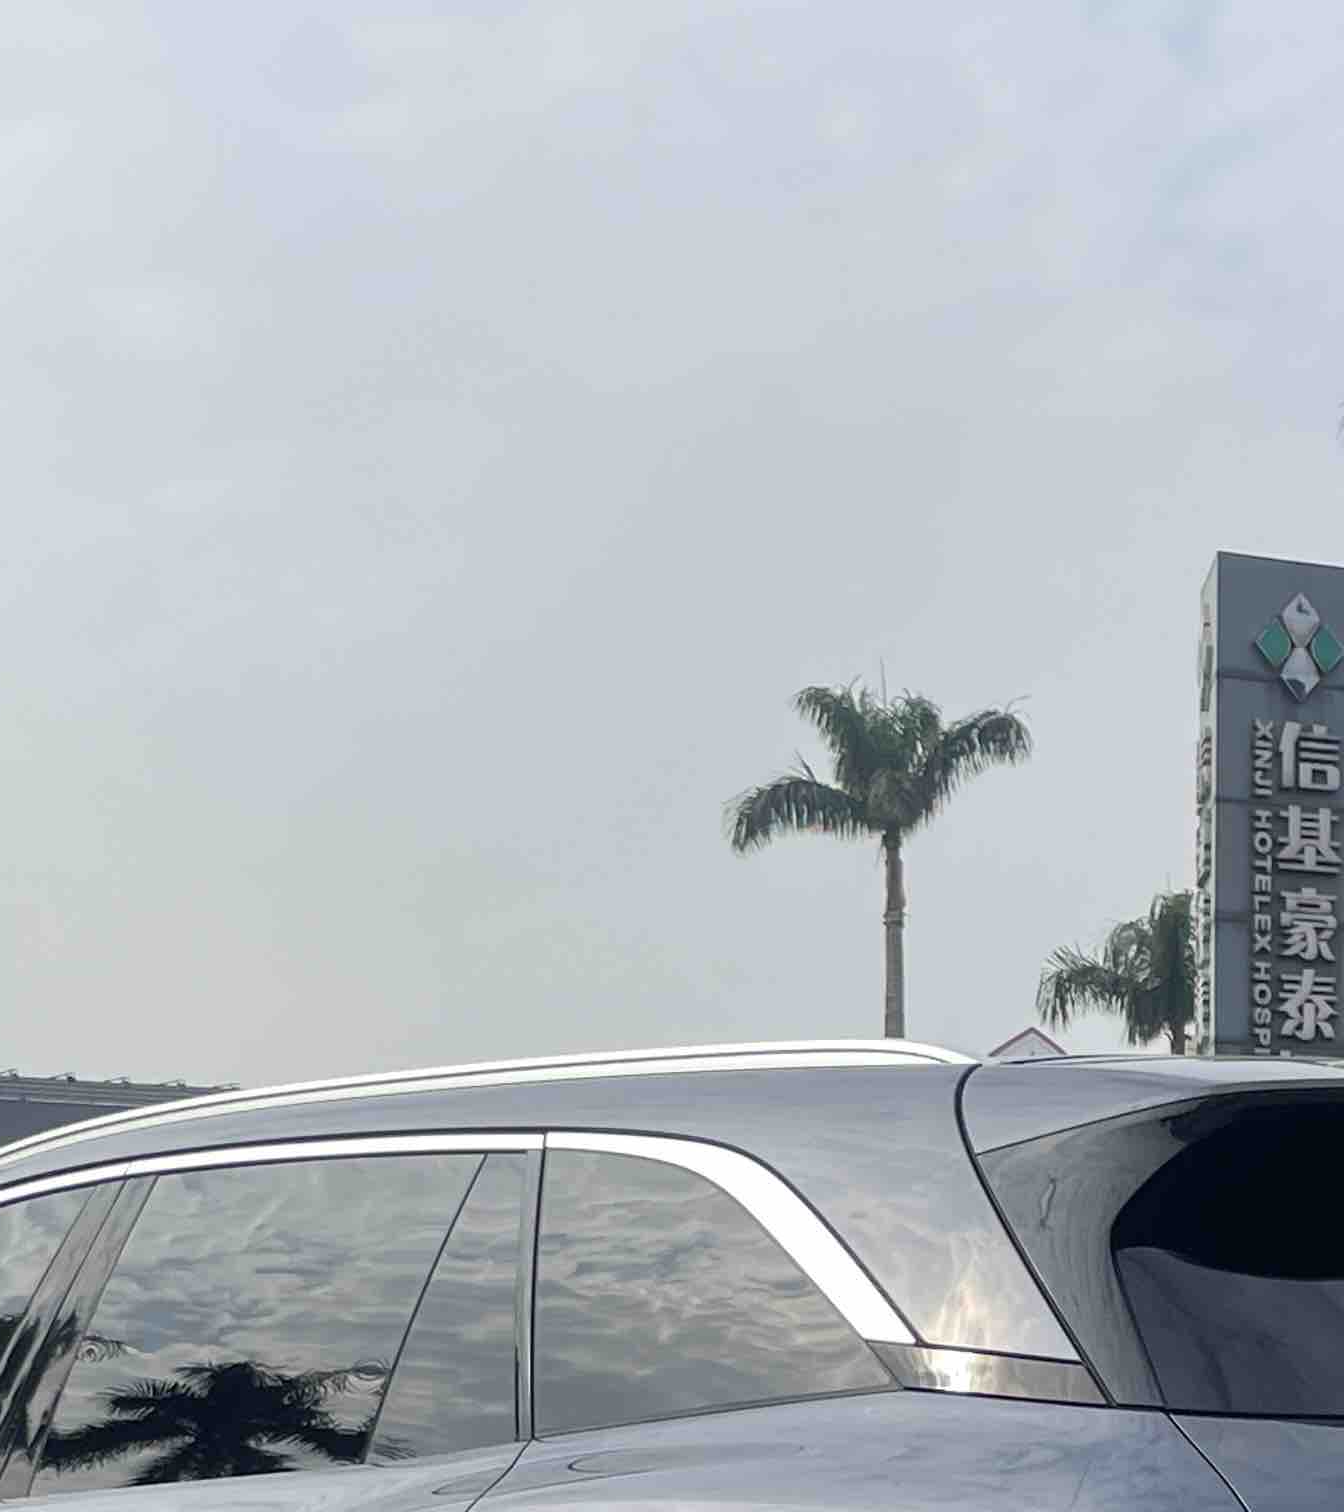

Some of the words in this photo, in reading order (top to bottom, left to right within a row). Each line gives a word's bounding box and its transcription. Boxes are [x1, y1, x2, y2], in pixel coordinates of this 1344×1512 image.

[1252, 720, 1274, 797] XINJI
[1252, 808, 1273, 953] HOTELEX
[1275, 720, 1344, 1042] 信基豪泰
